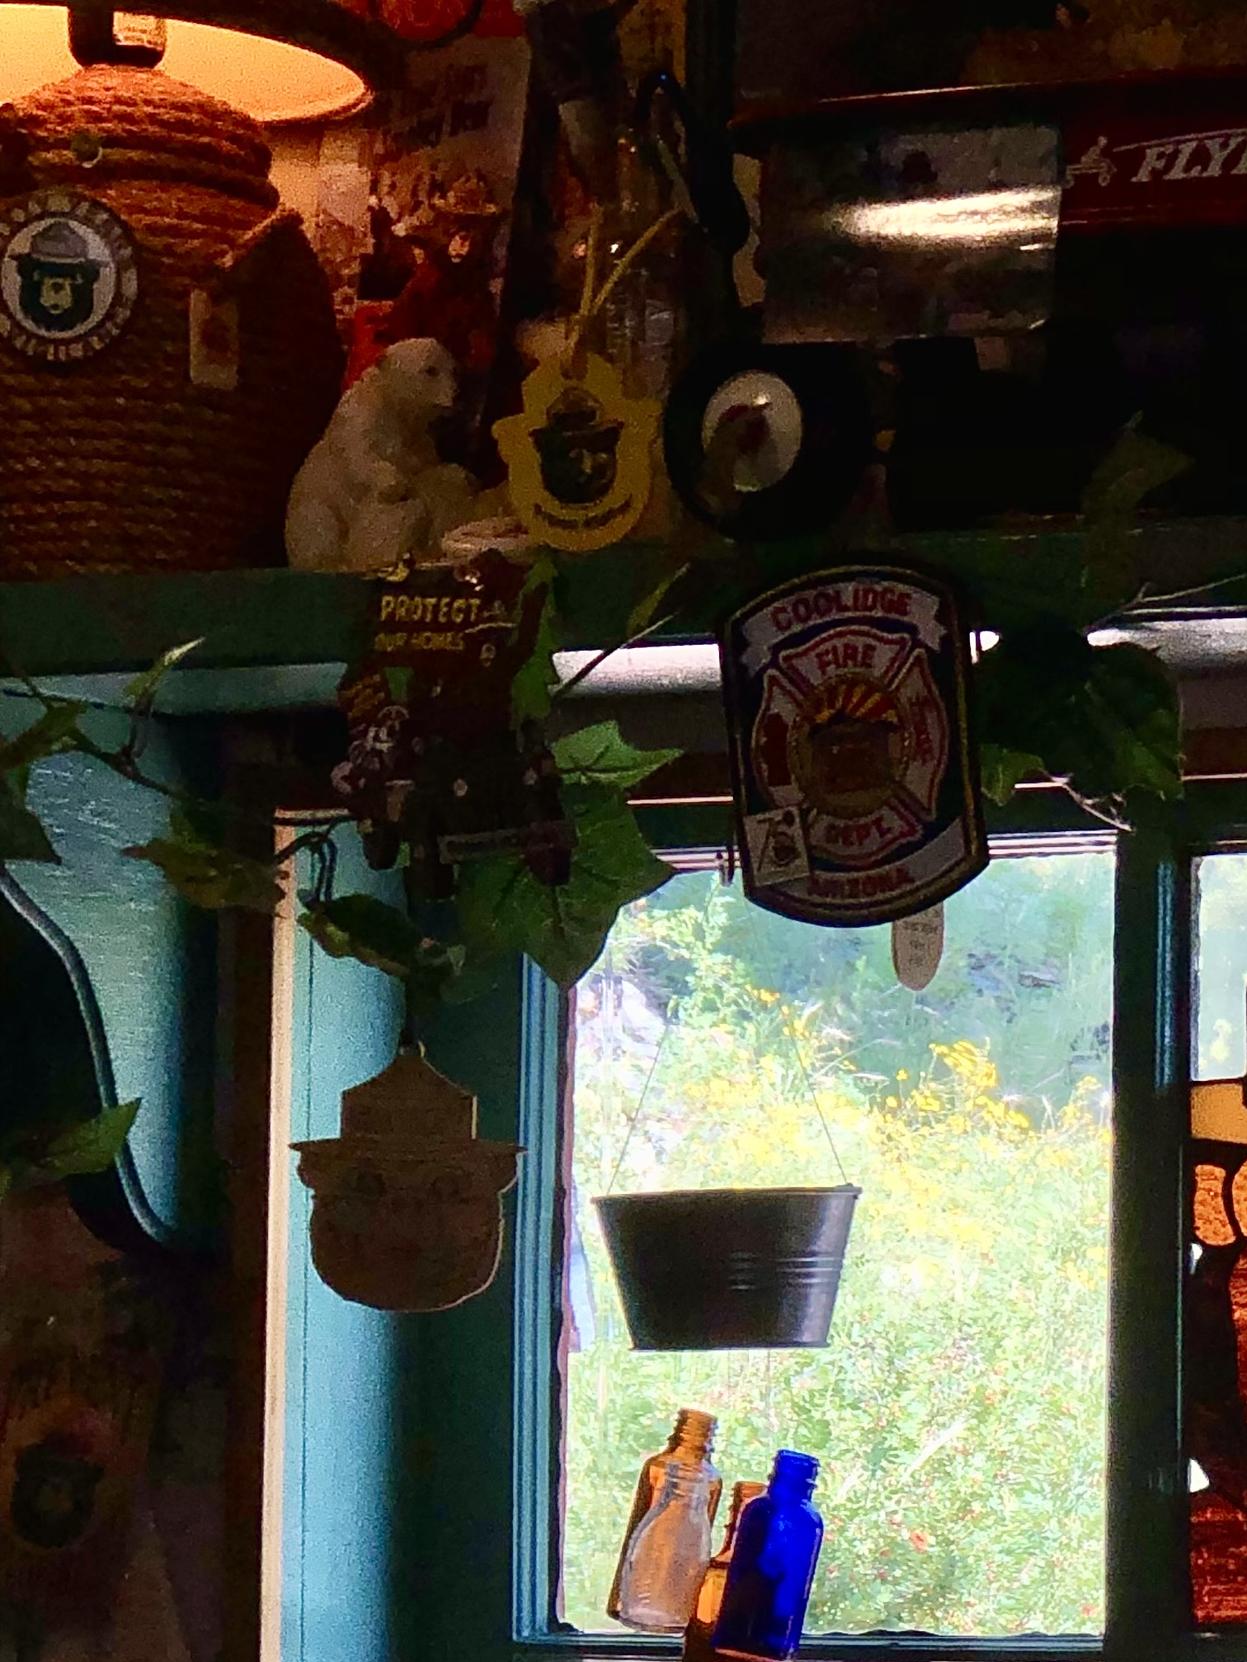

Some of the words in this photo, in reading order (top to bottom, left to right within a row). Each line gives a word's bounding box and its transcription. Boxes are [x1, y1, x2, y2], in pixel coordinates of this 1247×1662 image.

[379, 593, 481, 624] PROTECT
[771, 587, 913, 632] COOLIDGE
[815, 643, 877, 675] FIRE
